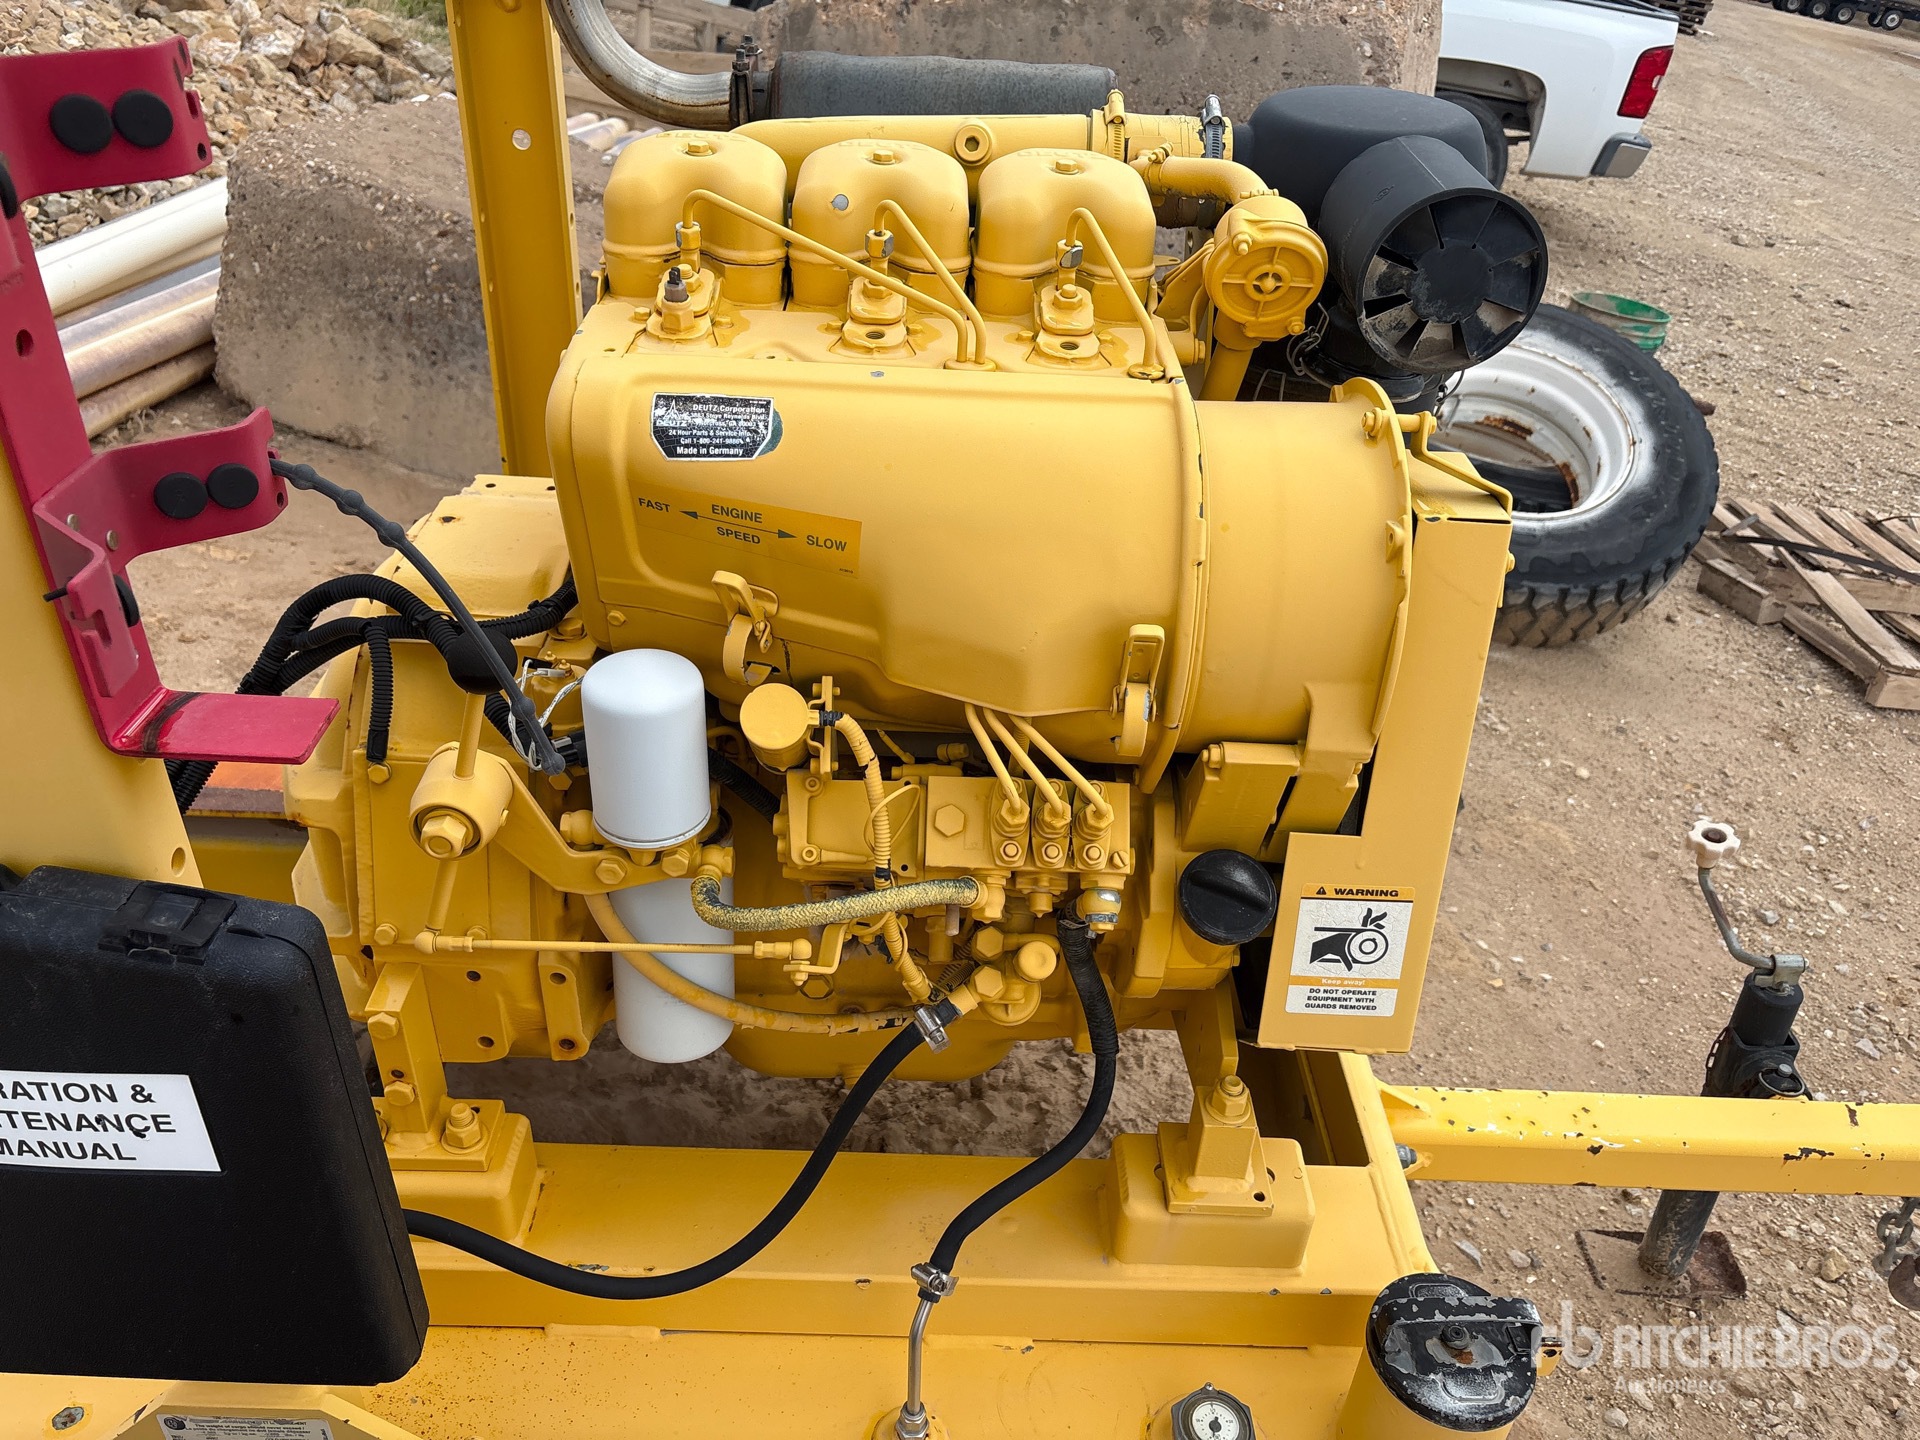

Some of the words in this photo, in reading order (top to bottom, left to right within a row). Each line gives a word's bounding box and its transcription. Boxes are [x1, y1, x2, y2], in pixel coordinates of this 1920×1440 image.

[693, 403, 717, 411] DEUTZ
[719, 405, 766, 414] Corporation
[677, 446, 699, 455] Made
[699, 446, 707, 455] in
[709, 446, 744, 456] Germany
[638, 497, 671, 513] FAST
[711, 503, 763, 524] ENGINE
[716, 526, 761, 545] SPEED
[806, 534, 847, 552] SLOW
[1334, 888, 1399, 897] WARNING
[1321, 978, 1341, 986] Keep
[130, 1084, 156, 1103] &
[0, 1110, 176, 1133] TENANCE
